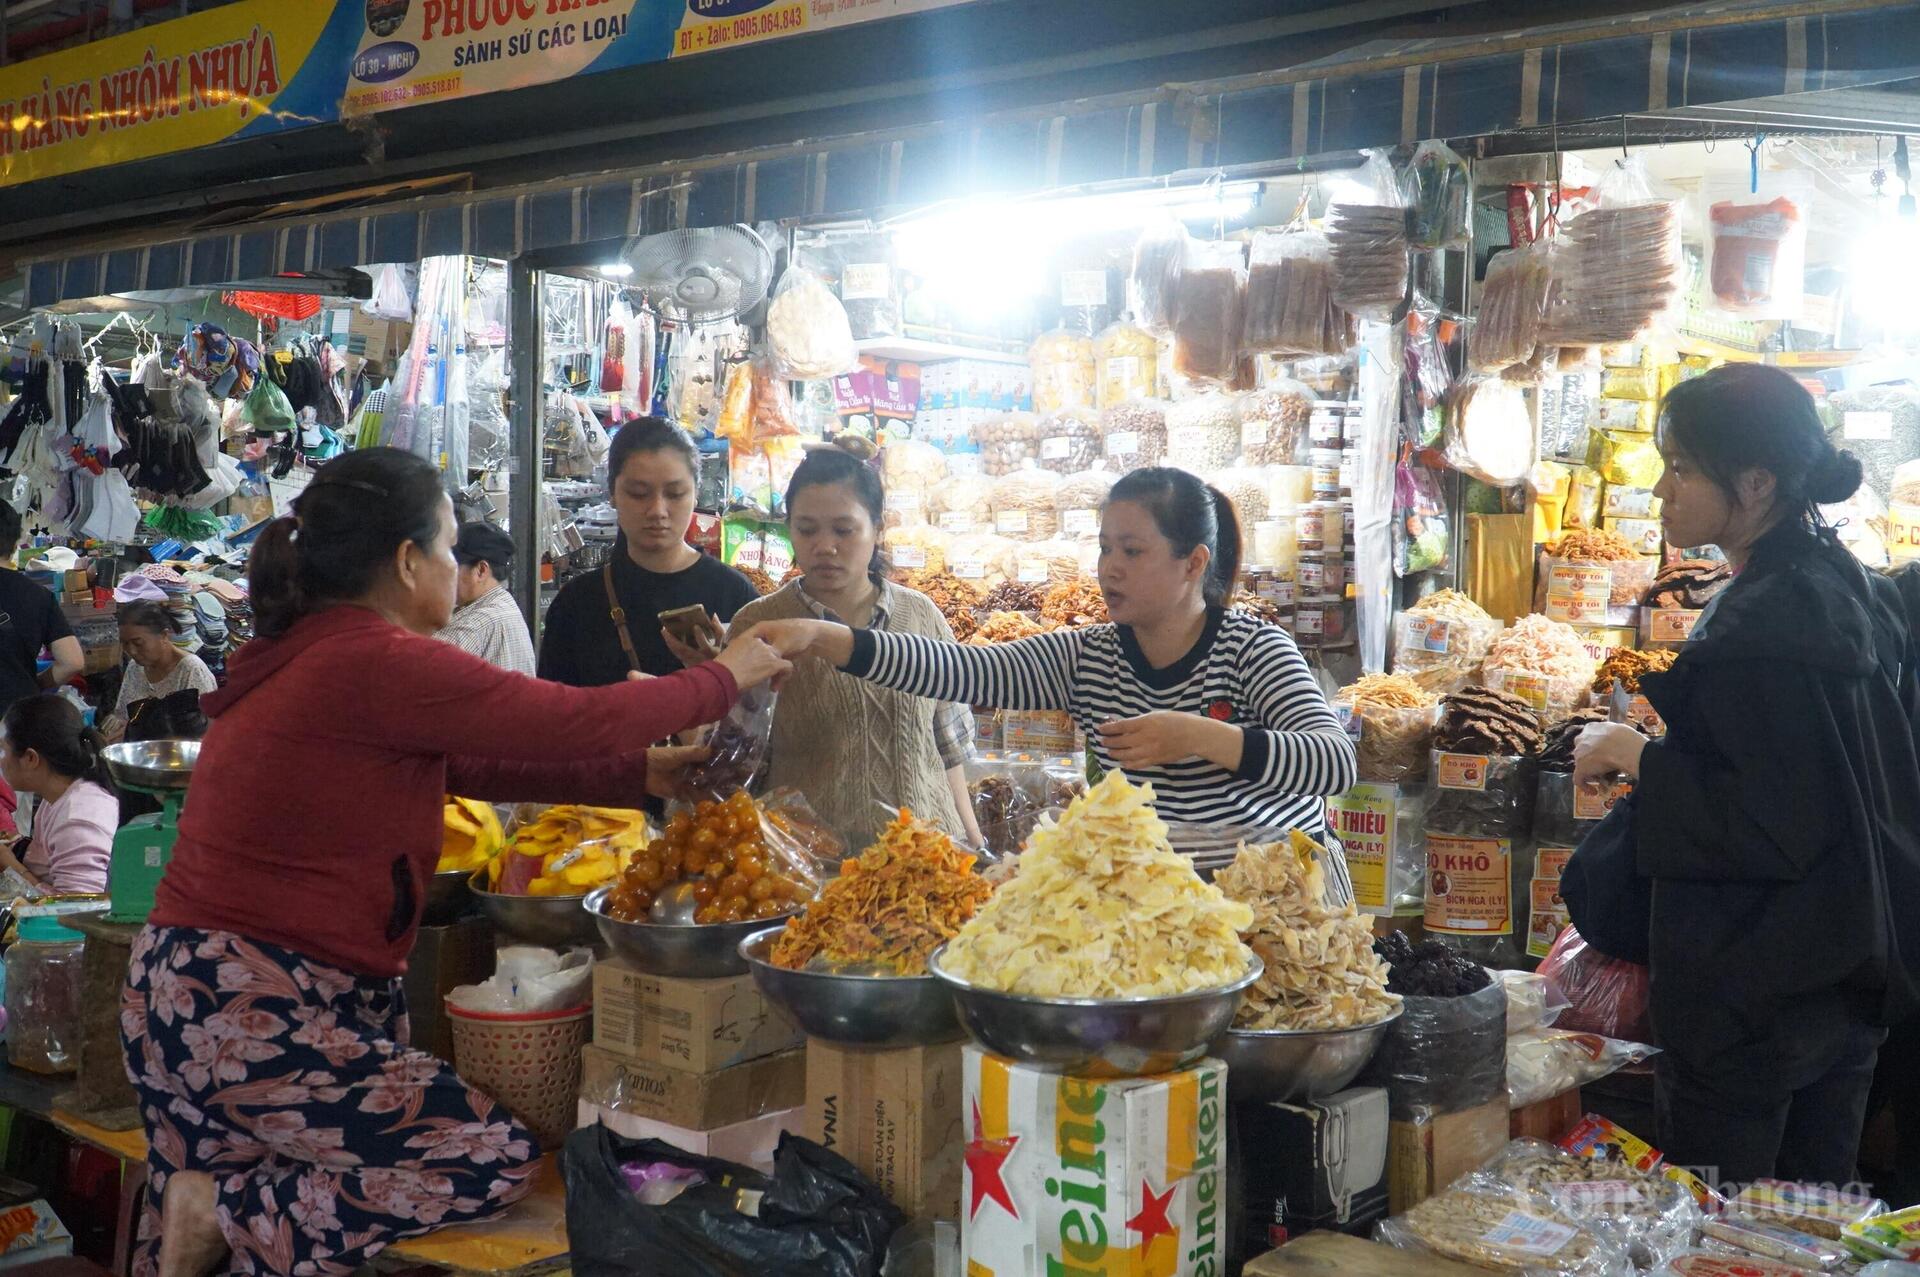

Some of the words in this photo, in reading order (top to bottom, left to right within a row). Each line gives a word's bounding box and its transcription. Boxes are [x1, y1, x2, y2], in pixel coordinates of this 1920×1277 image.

[453, 39, 502, 67] SÀNH
[508, 27, 533, 57] SỨ
[537, 21, 576, 51] CÁC
[583, 13, 628, 42] LOẠI
[708, 24, 730, 45] Zalo:
[733, 7, 802, 39] 0905.064.843
[99, 46, 181, 133] NHÔM
[187, 23, 281, 119] NHỰA
[354, 57, 367, 77] LÔ
[368, 58, 380, 74] 30
[388, 51, 416, 70] MCHV
[1445, 851, 1490, 872] KHÔ
[823, 1094, 838, 1148] VINA
